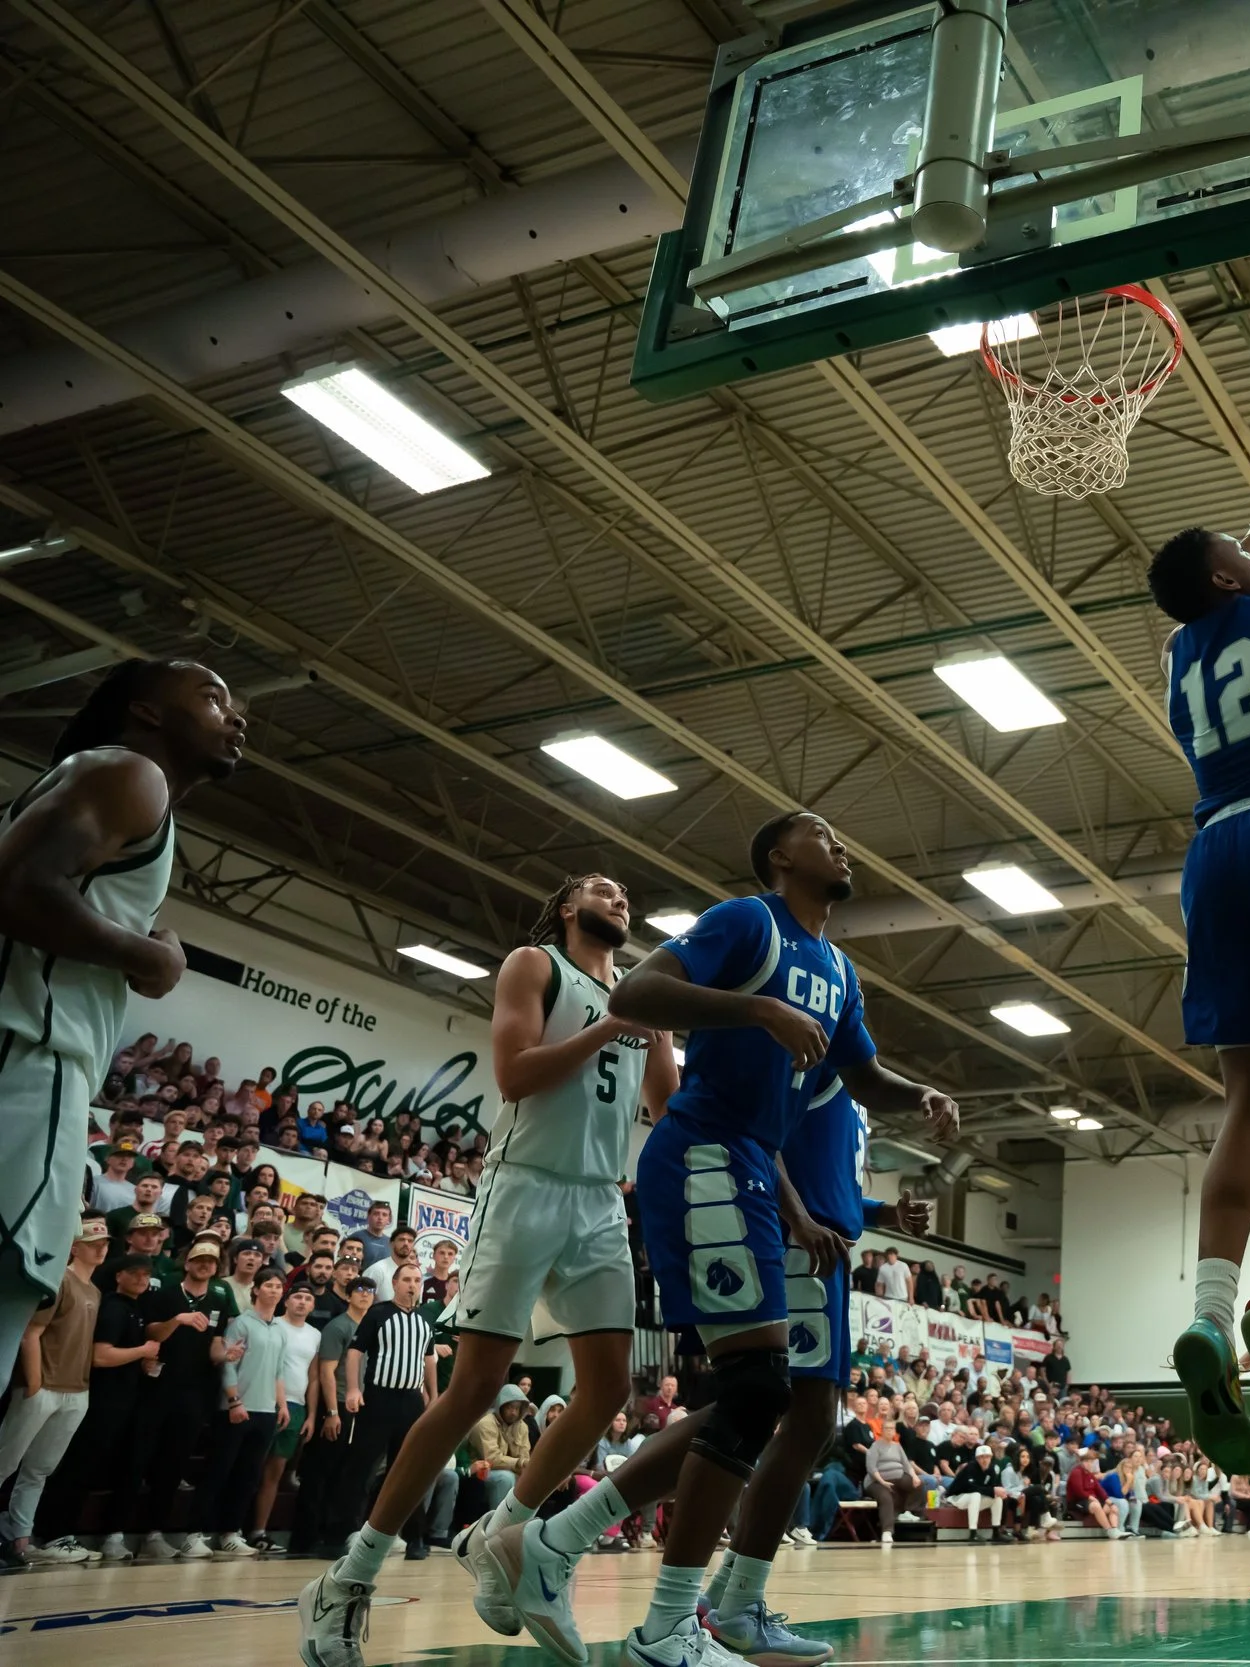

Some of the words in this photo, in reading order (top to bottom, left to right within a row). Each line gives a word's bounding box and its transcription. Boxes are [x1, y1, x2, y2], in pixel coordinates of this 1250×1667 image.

[241, 967, 312, 1010] Home
[315, 997, 341, 1023] of
[343, 1003, 377, 1032] the
[787, 966, 842, 1021] CBC
[596, 1049, 620, 1105] 5
[416, 1204, 471, 1242] NAIA
